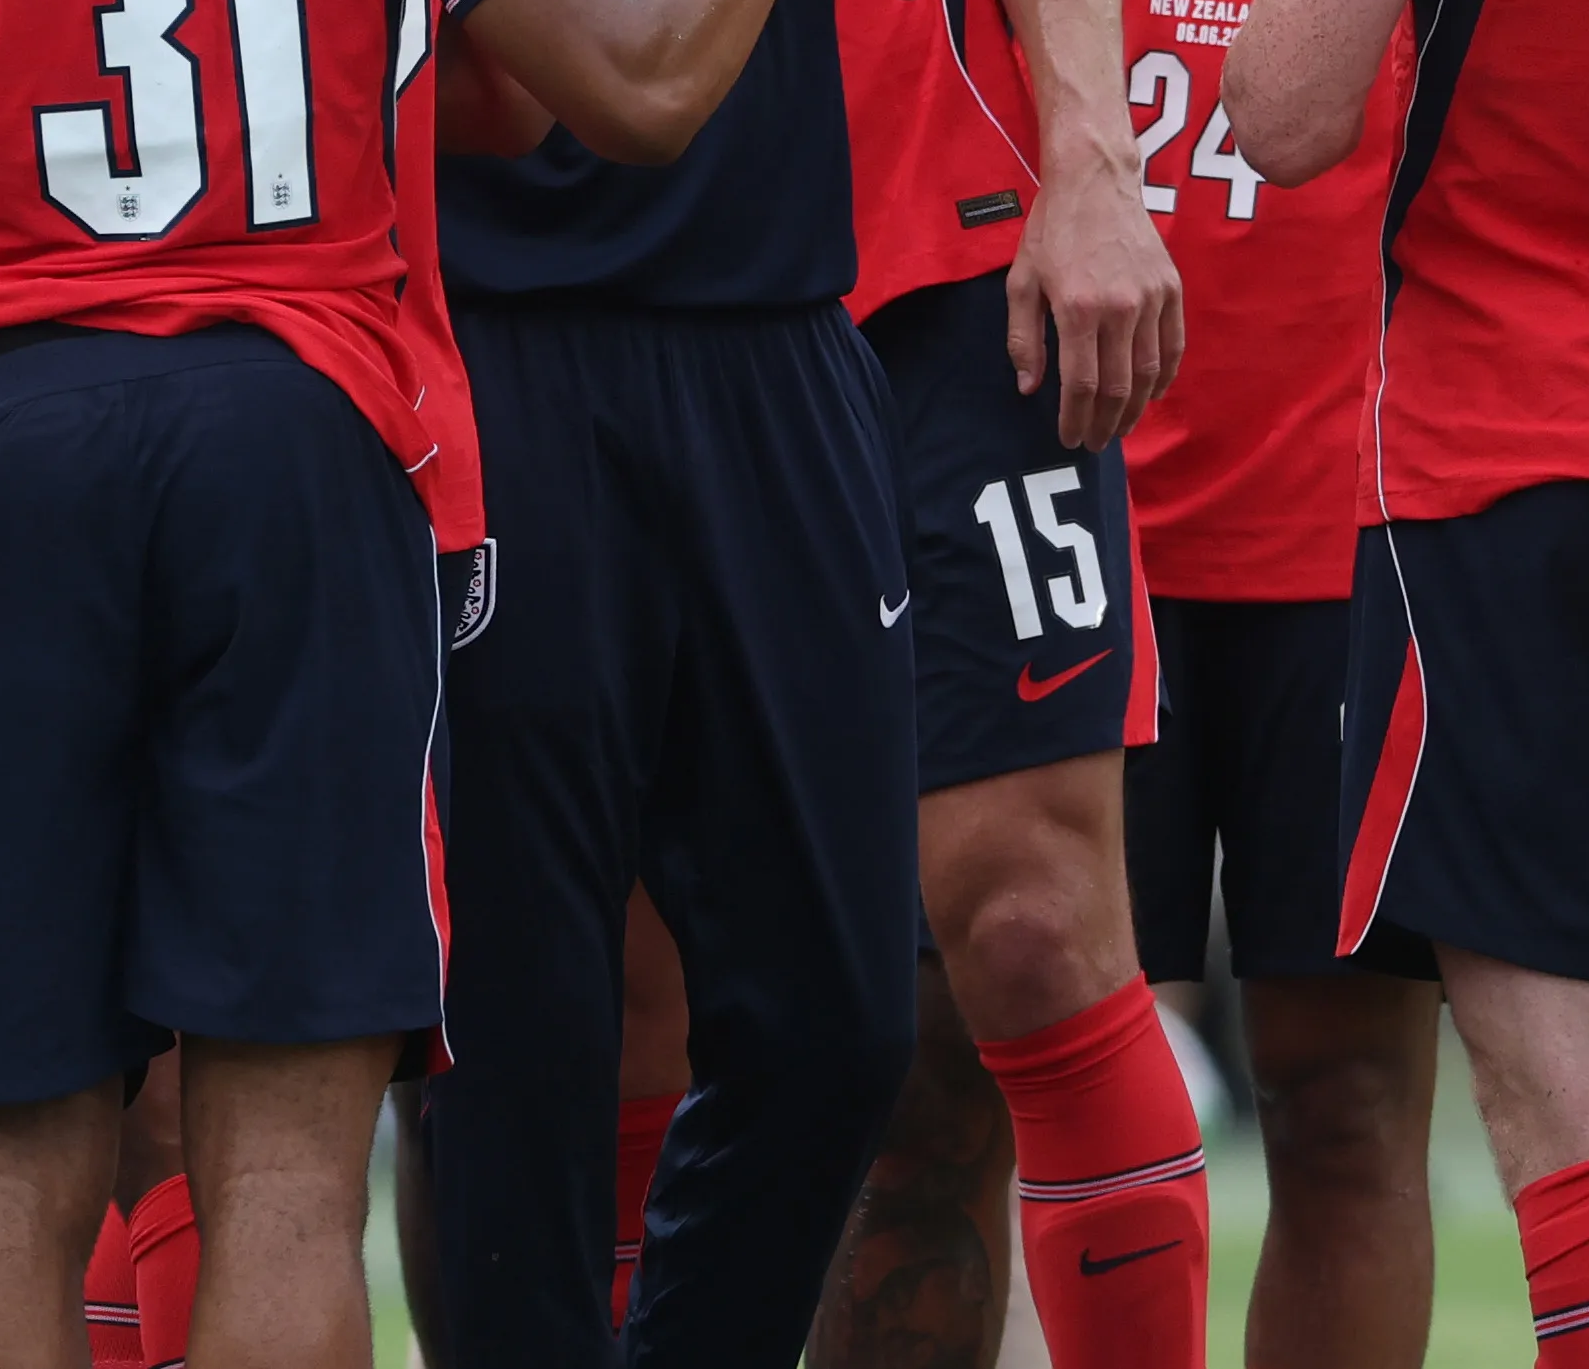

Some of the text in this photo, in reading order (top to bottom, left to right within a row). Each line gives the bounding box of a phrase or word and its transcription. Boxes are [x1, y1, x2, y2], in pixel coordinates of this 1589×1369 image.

[1191, 0, 1250, 23] ZEALA
[1128, 49, 1267, 221] 24
[972, 465, 1108, 641] 15
